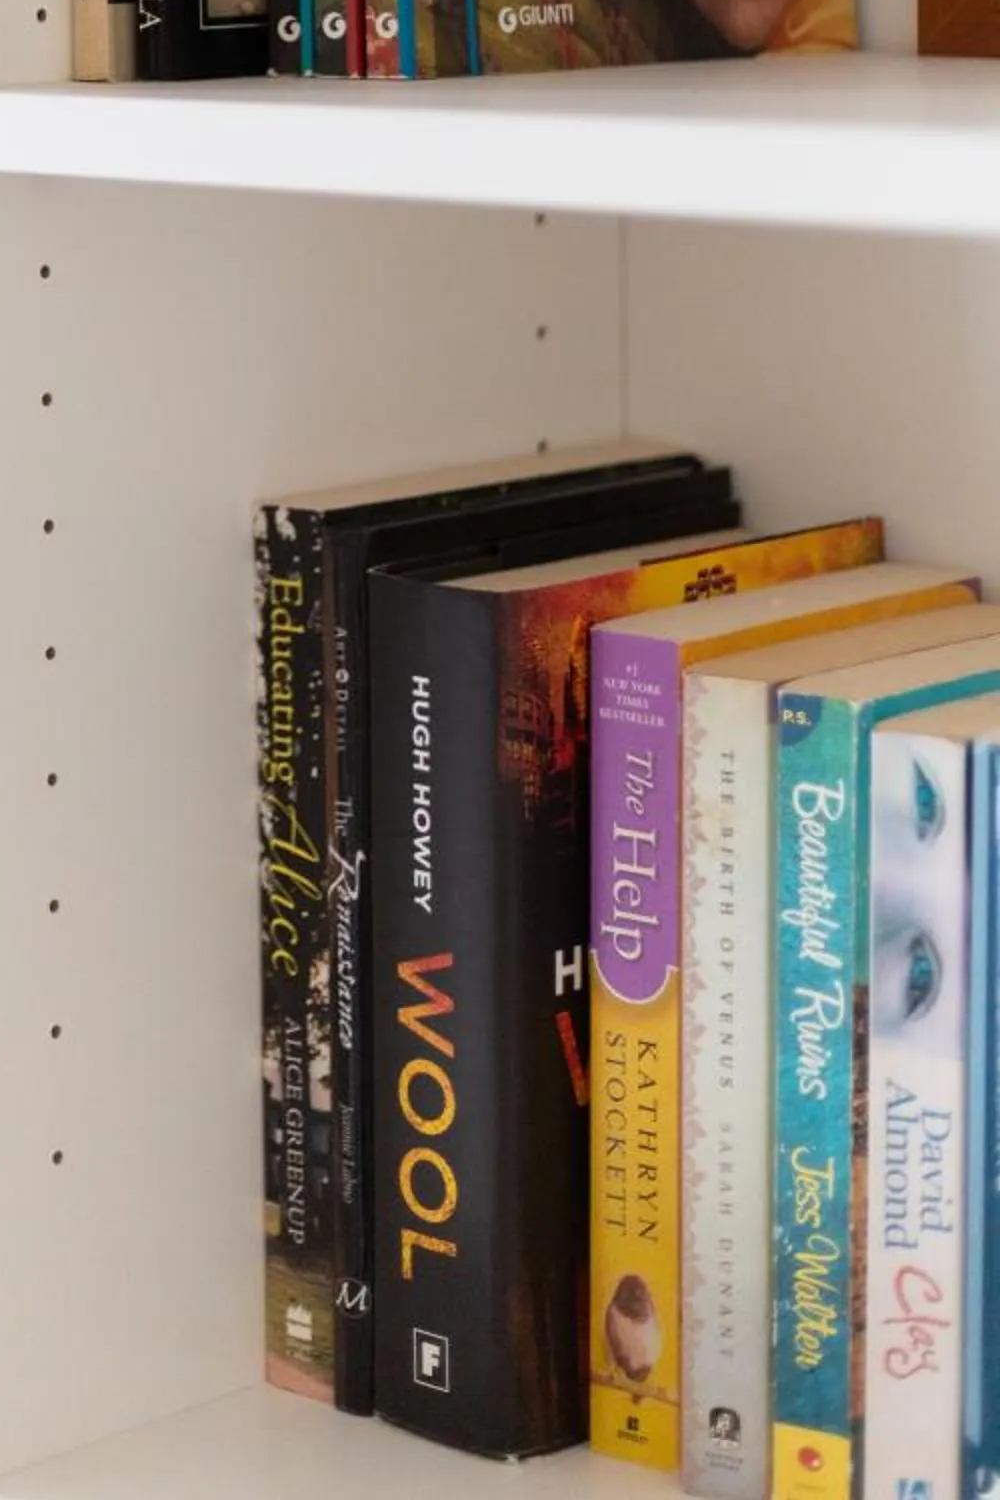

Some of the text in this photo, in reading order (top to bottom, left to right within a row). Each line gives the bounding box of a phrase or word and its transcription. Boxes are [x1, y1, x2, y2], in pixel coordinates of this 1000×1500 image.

[519, 3, 574, 26] GIUNTI
[265, 575, 305, 784] Educating
[599, 707, 667, 727] BESTSELLER
[603, 677, 662, 696] NEW YORK
[616, 694, 649, 710] TIMES
[782, 708, 811, 727] P.S.
[334, 796, 354, 836] The
[412, 675, 432, 914] HUGH HOWEY
[624, 751, 655, 816] The
[266, 796, 323, 978] Alice
[327, 834, 367, 1051] Renaissance
[601, 820, 658, 962] Help
[718, 749, 735, 1091] THE BIRTH OF VENUS
[781, 779, 844, 971] Beautiful
[397, 953, 458, 1282] WOOL
[789, 979, 845, 1100] Ruins
[283, 1016, 305, 1245] ALICE GREENUP
[605, 1031, 628, 1237] STOCKETT
[636, 1037, 659, 1244] KATHRYN
[790, 1147, 836, 1229] Jess
[885, 1080, 919, 1251] Almond
[919, 1107, 953, 1235] David
[717, 1121, 735, 1365] SARAH DUNANT
